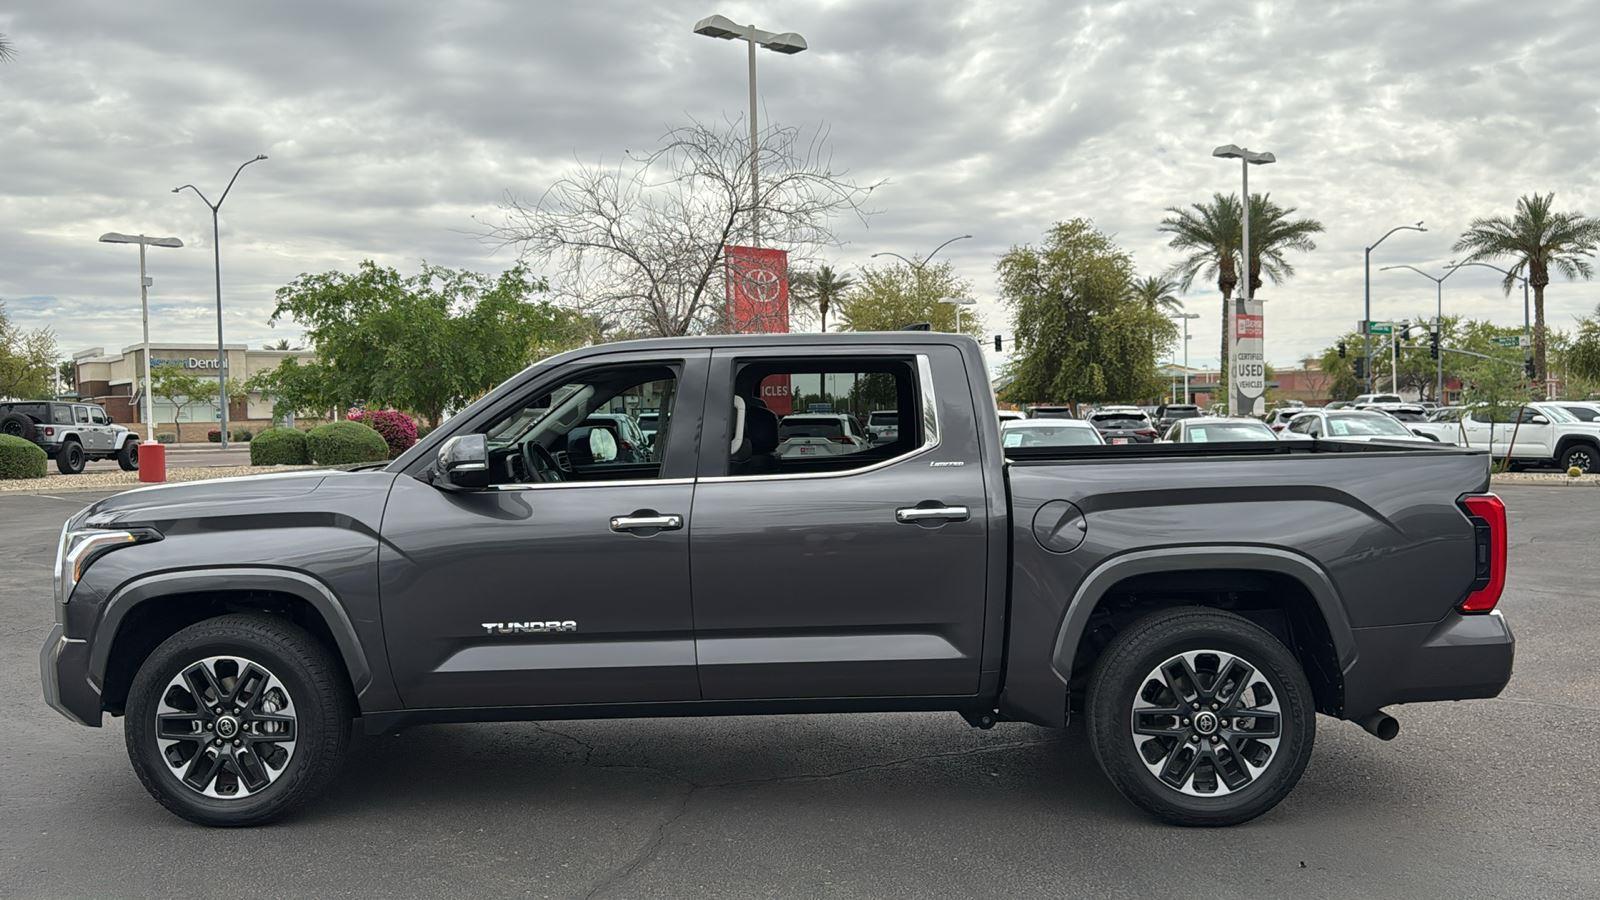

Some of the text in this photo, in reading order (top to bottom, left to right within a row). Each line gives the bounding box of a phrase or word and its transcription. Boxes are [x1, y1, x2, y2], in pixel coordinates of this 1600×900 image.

[1238, 353, 1264, 361] CERTIFIED
[1239, 364, 1263, 377] USED
[1239, 381, 1263, 389] VEHICLES
[761, 386, 788, 397] ICLES
[481, 620, 577, 634] TUNDRA
